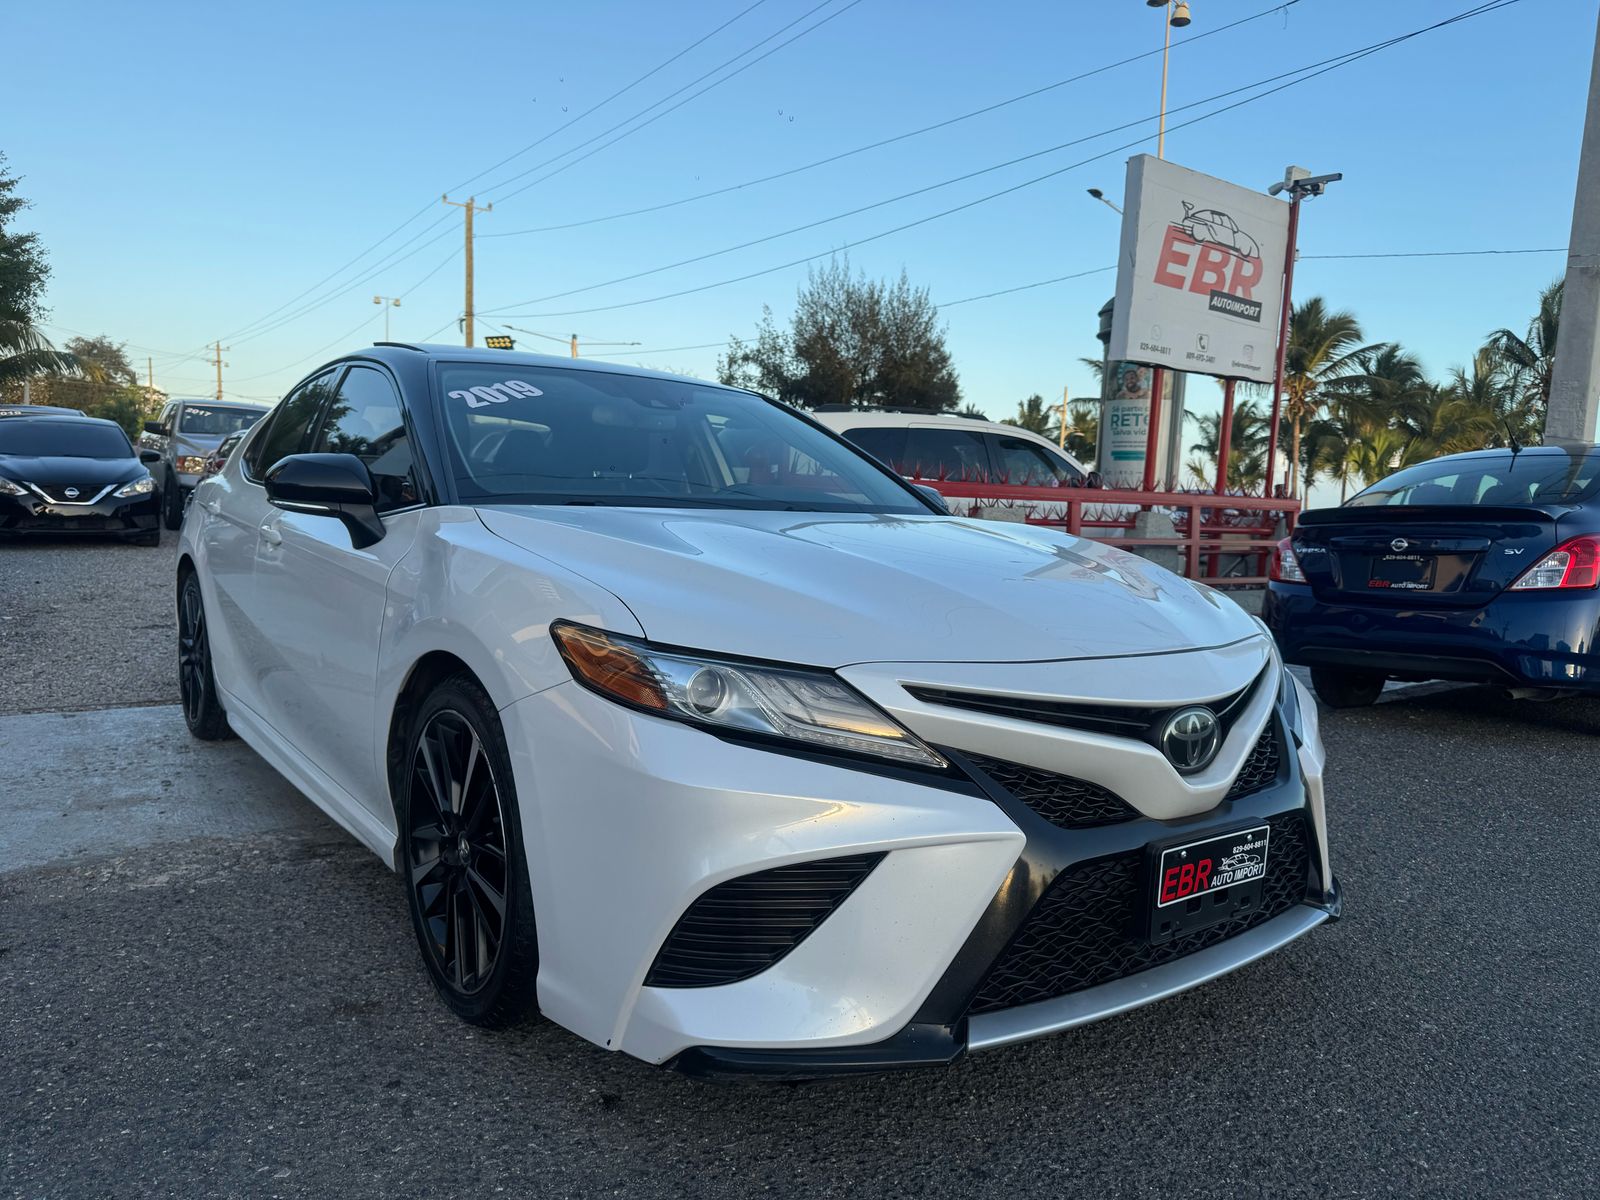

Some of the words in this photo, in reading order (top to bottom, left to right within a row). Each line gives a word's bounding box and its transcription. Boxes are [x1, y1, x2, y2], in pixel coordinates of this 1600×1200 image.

[1153, 225, 1263, 300] EBR
[1210, 296, 1260, 317] AUTOIMPORT
[448, 380, 544, 408] 2019
[1504, 547, 1525, 555] SV
[1232, 839, 1267, 854] 829-604-8811
[1161, 858, 1213, 903] EBR
[1210, 872, 1233, 887] AUTO
[1234, 863, 1264, 881] IMPORT
